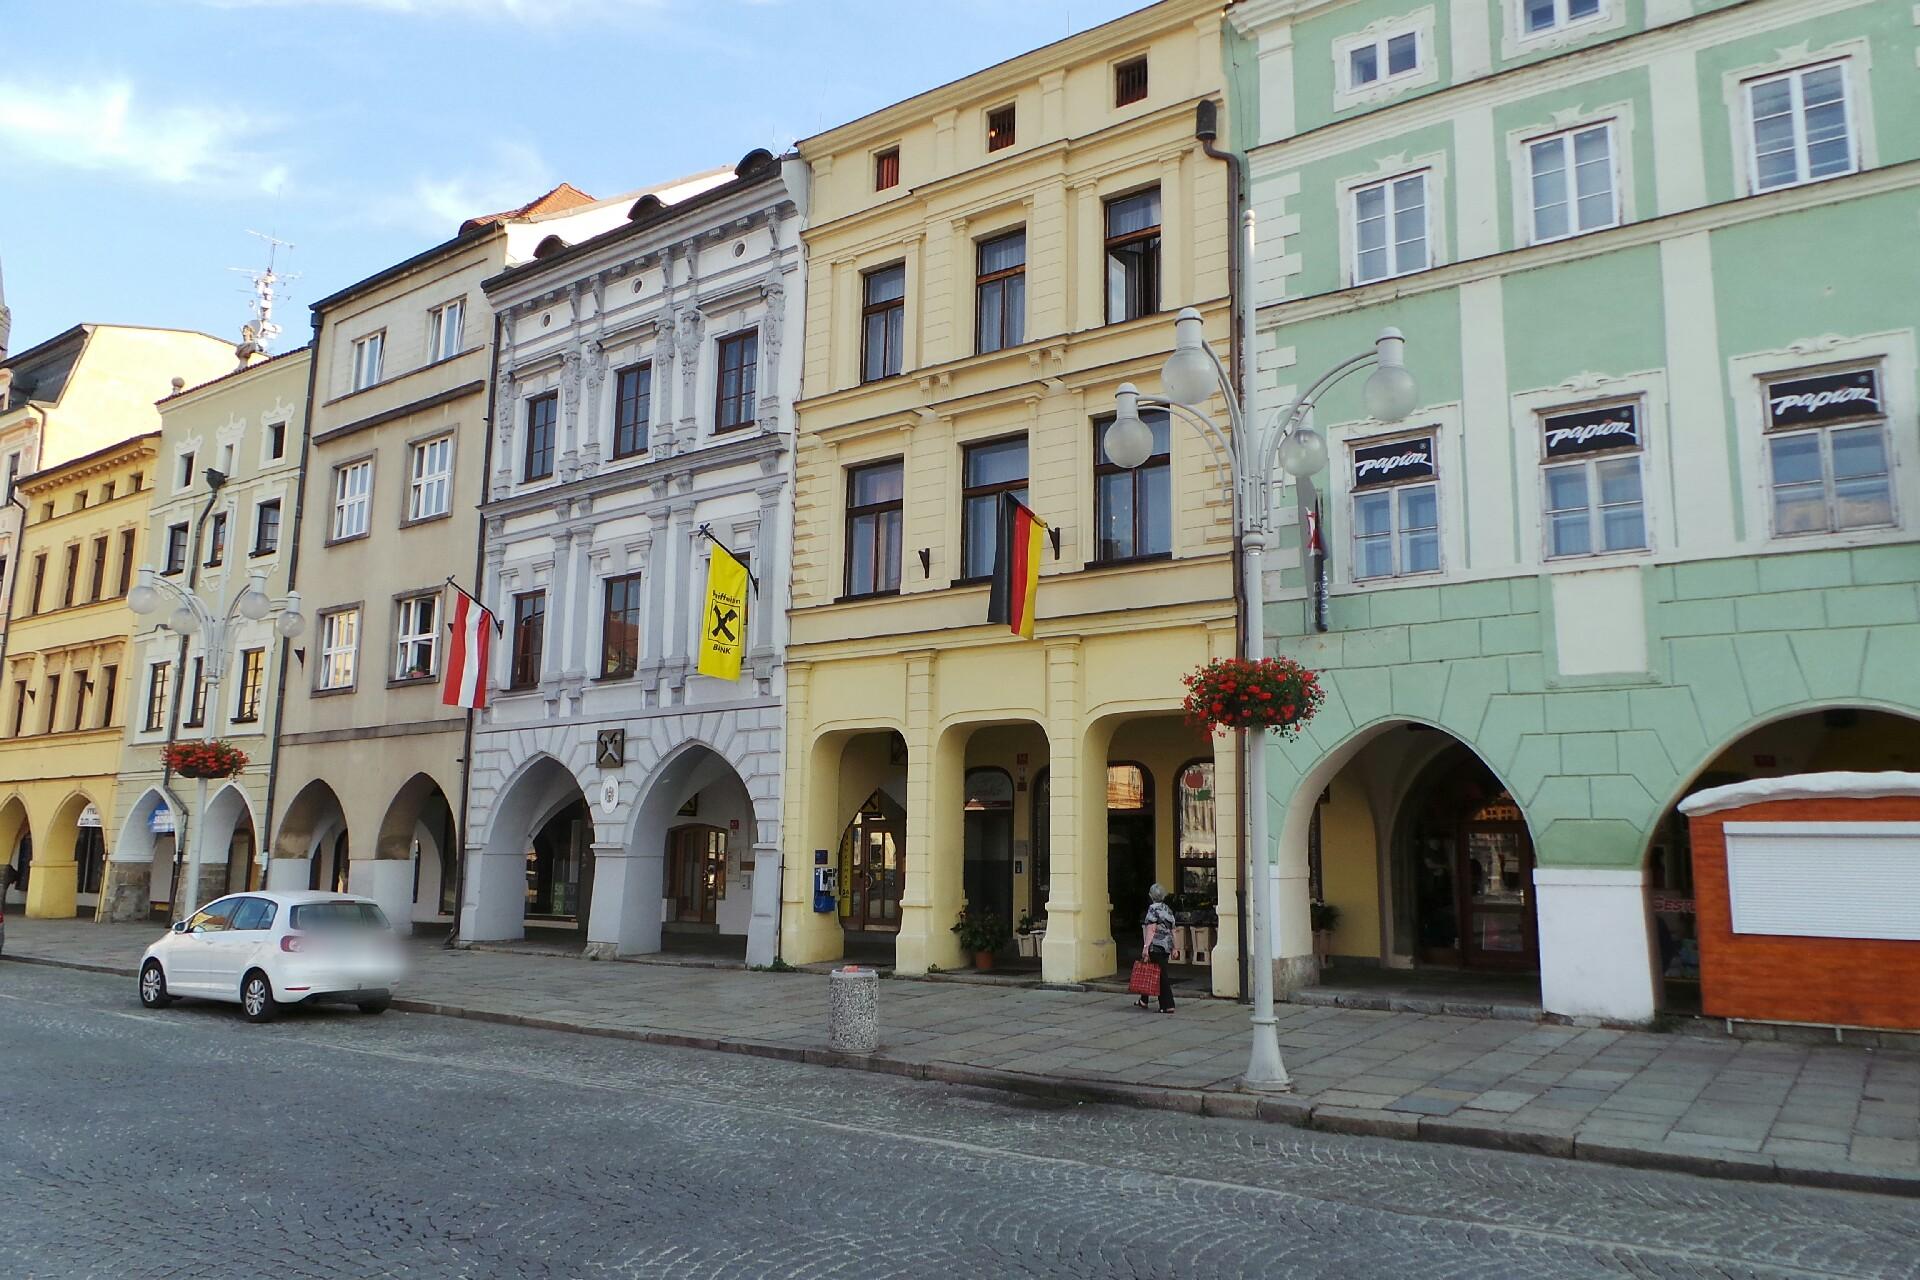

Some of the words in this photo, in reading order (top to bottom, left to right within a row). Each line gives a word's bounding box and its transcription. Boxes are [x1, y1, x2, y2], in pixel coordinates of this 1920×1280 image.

[1769, 386, 1879, 415] papion
[1545, 418, 1636, 448] papion
[1355, 451, 1433, 477] papion
